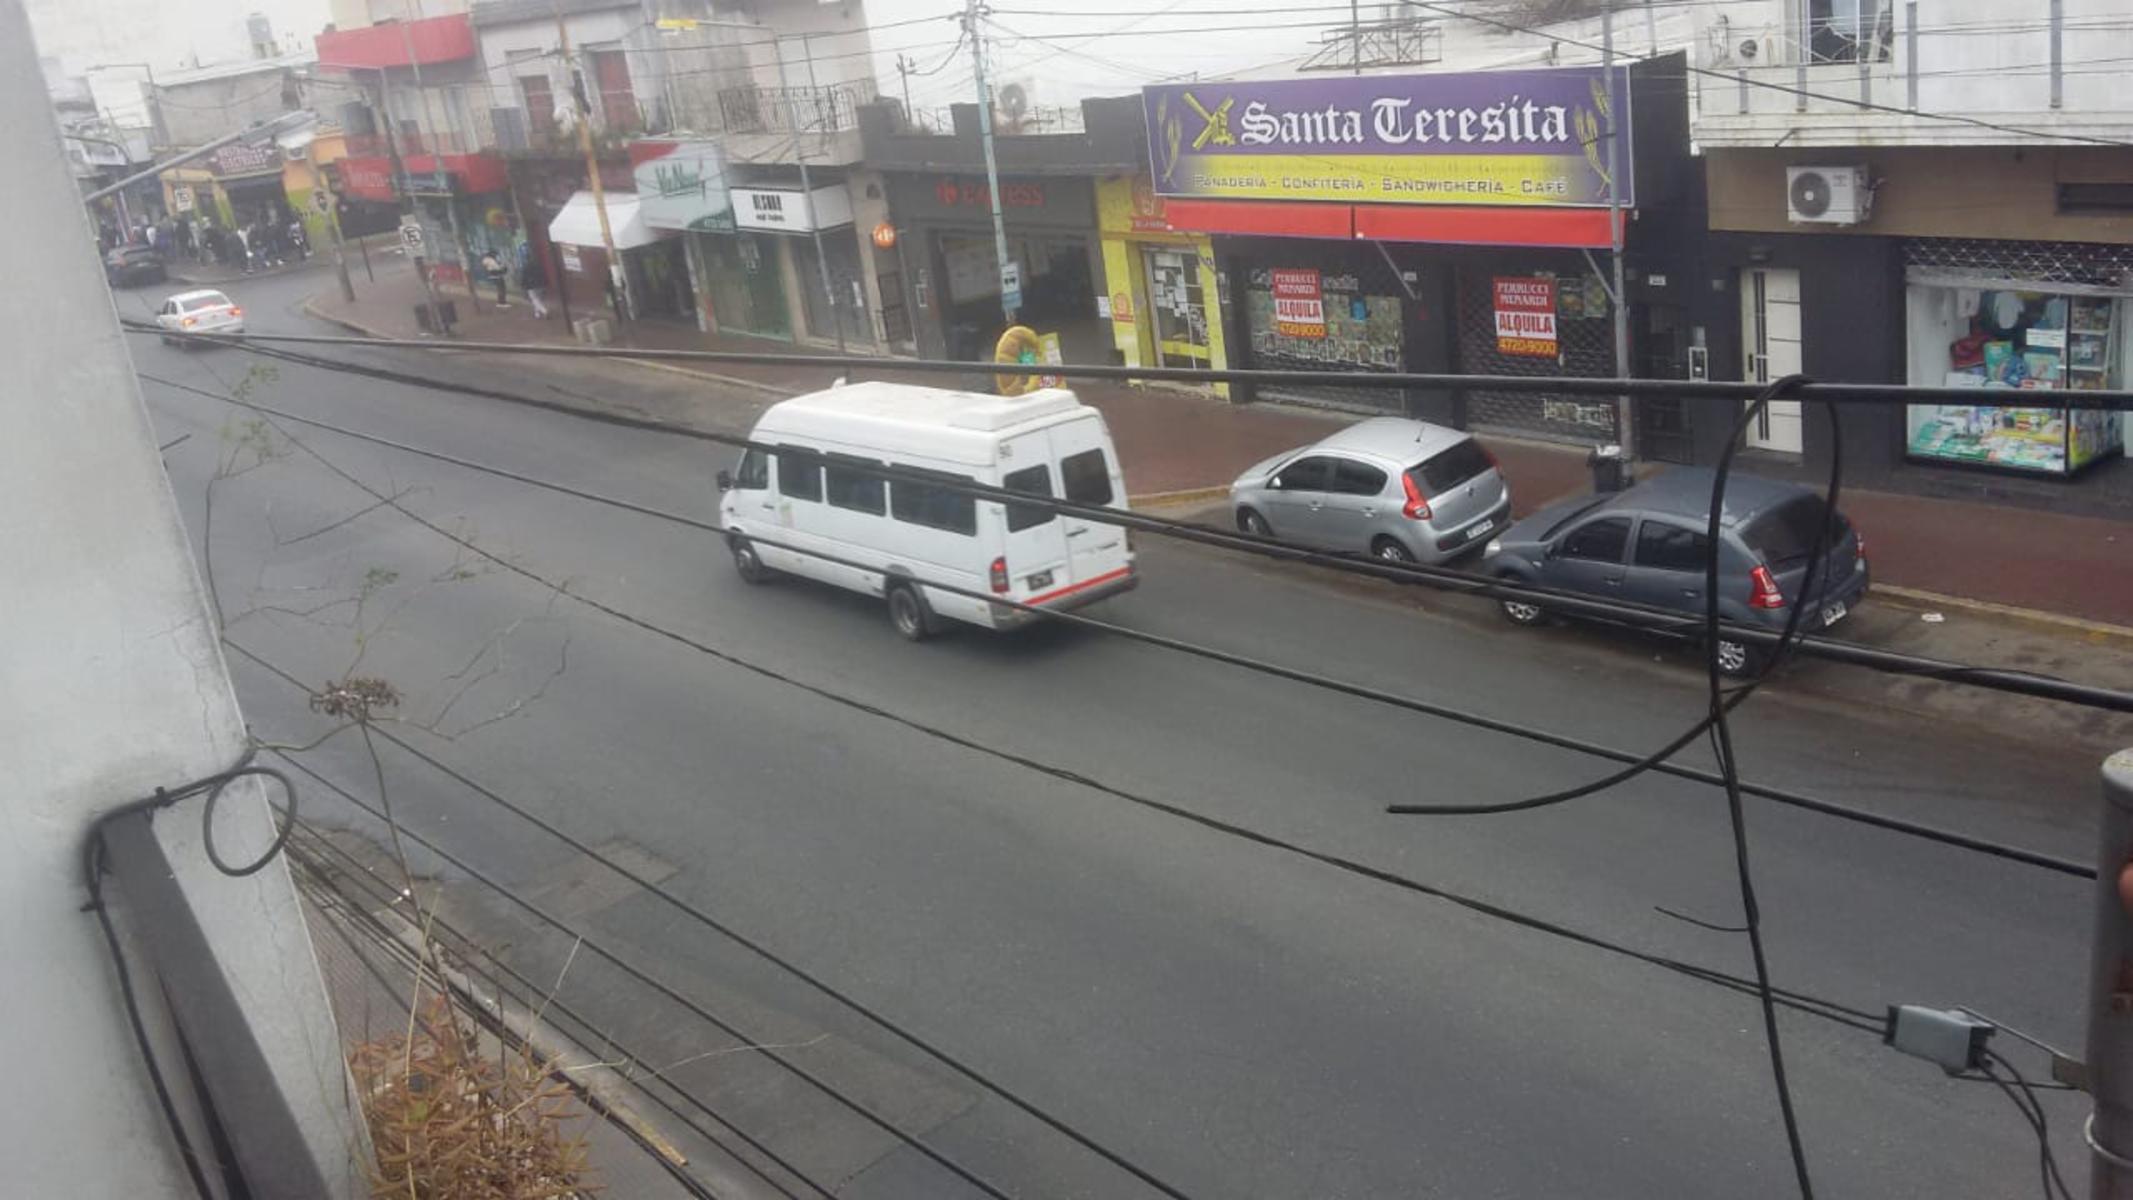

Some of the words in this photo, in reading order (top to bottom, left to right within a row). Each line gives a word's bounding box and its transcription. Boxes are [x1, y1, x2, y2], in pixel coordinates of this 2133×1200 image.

[1240, 100, 1365, 145] Santa
[1370, 94, 1569, 144] Teresita
[1497, 282, 1550, 295] PERRUCCI
[1278, 301, 1322, 321] ALQUILA
[1499, 313, 1554, 336] ALQUILA
